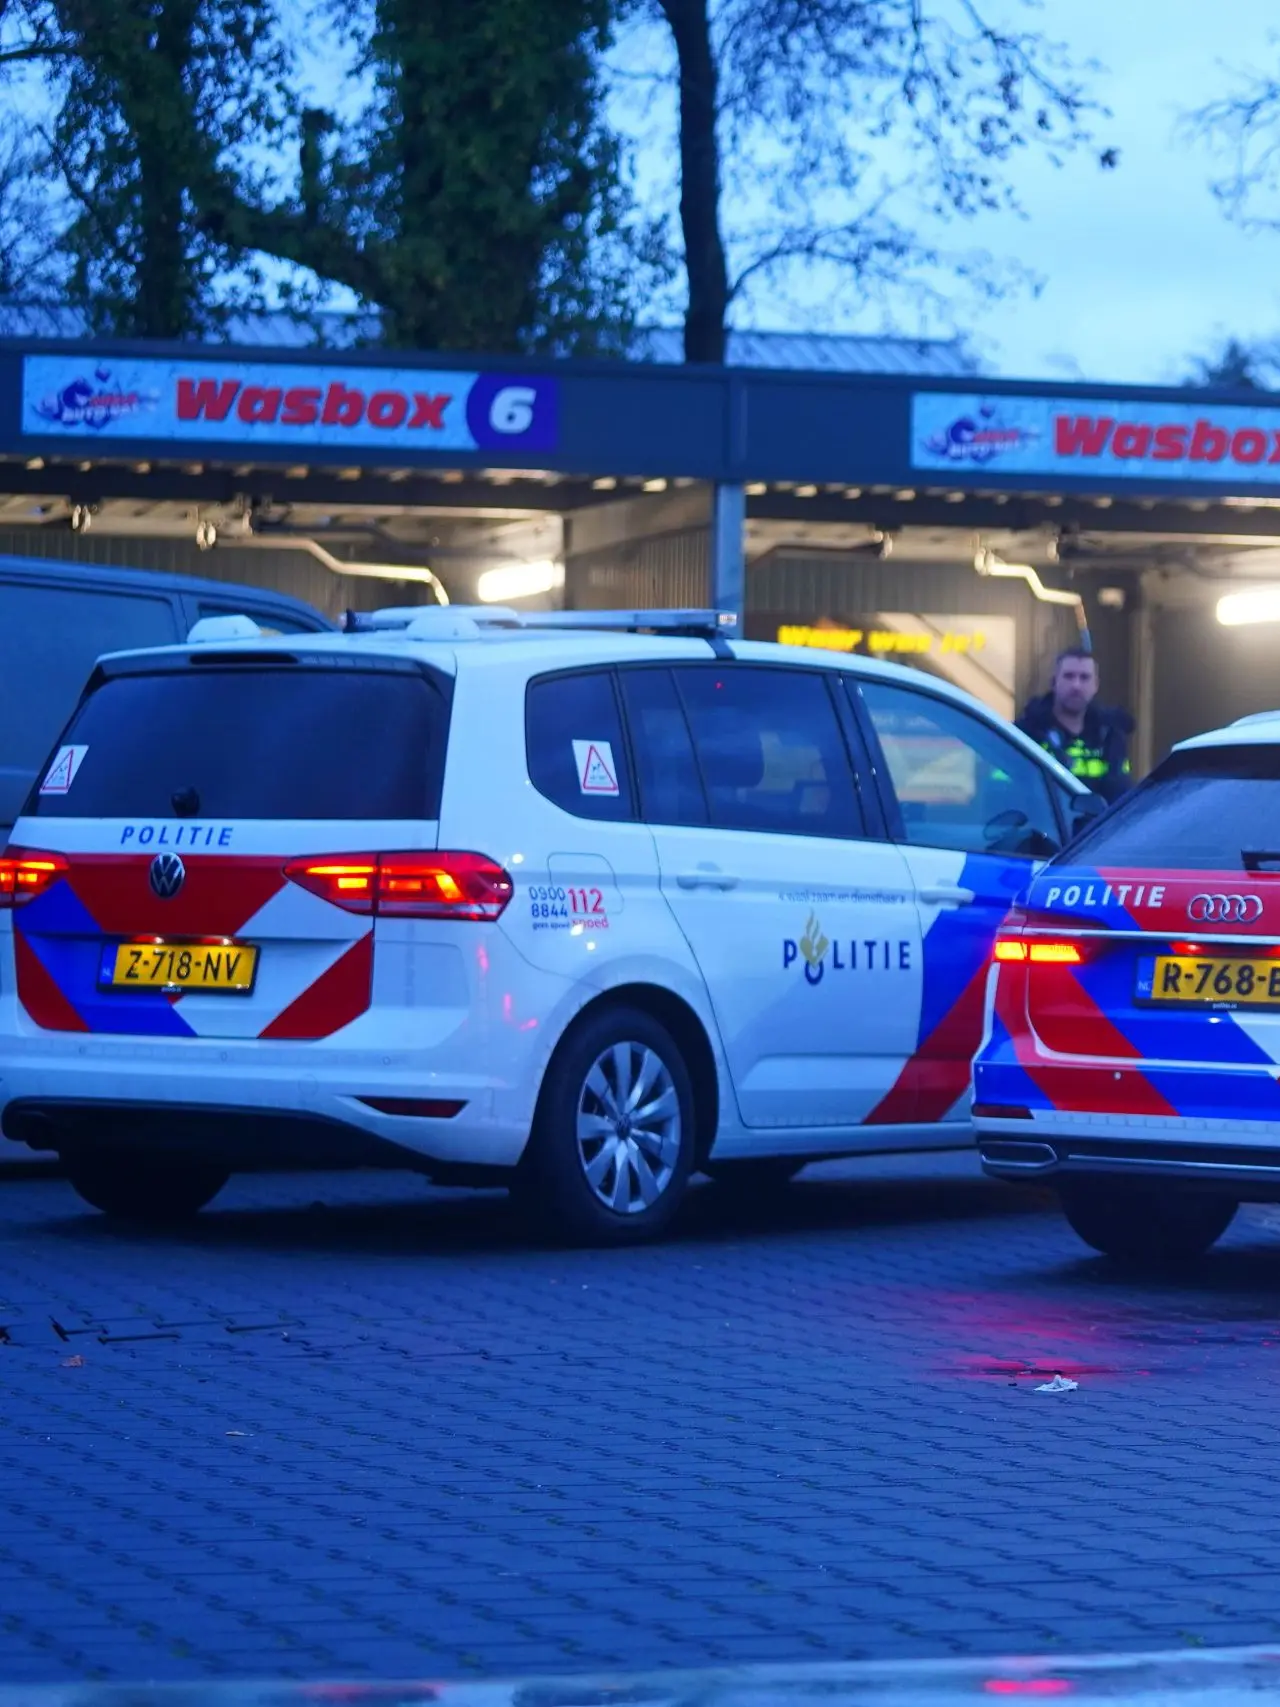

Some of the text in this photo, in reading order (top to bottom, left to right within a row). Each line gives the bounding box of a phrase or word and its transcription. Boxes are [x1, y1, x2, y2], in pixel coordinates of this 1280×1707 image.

[175, 379, 537, 434] Wasbox 6
[120, 826, 233, 846] POLITIE
[528, 886, 566, 901] 0900
[568, 888, 605, 914] 112
[1045, 885, 1165, 908] POLITIE
[531, 903, 568, 918] 8844
[125, 950, 241, 981] Z-718-NV
